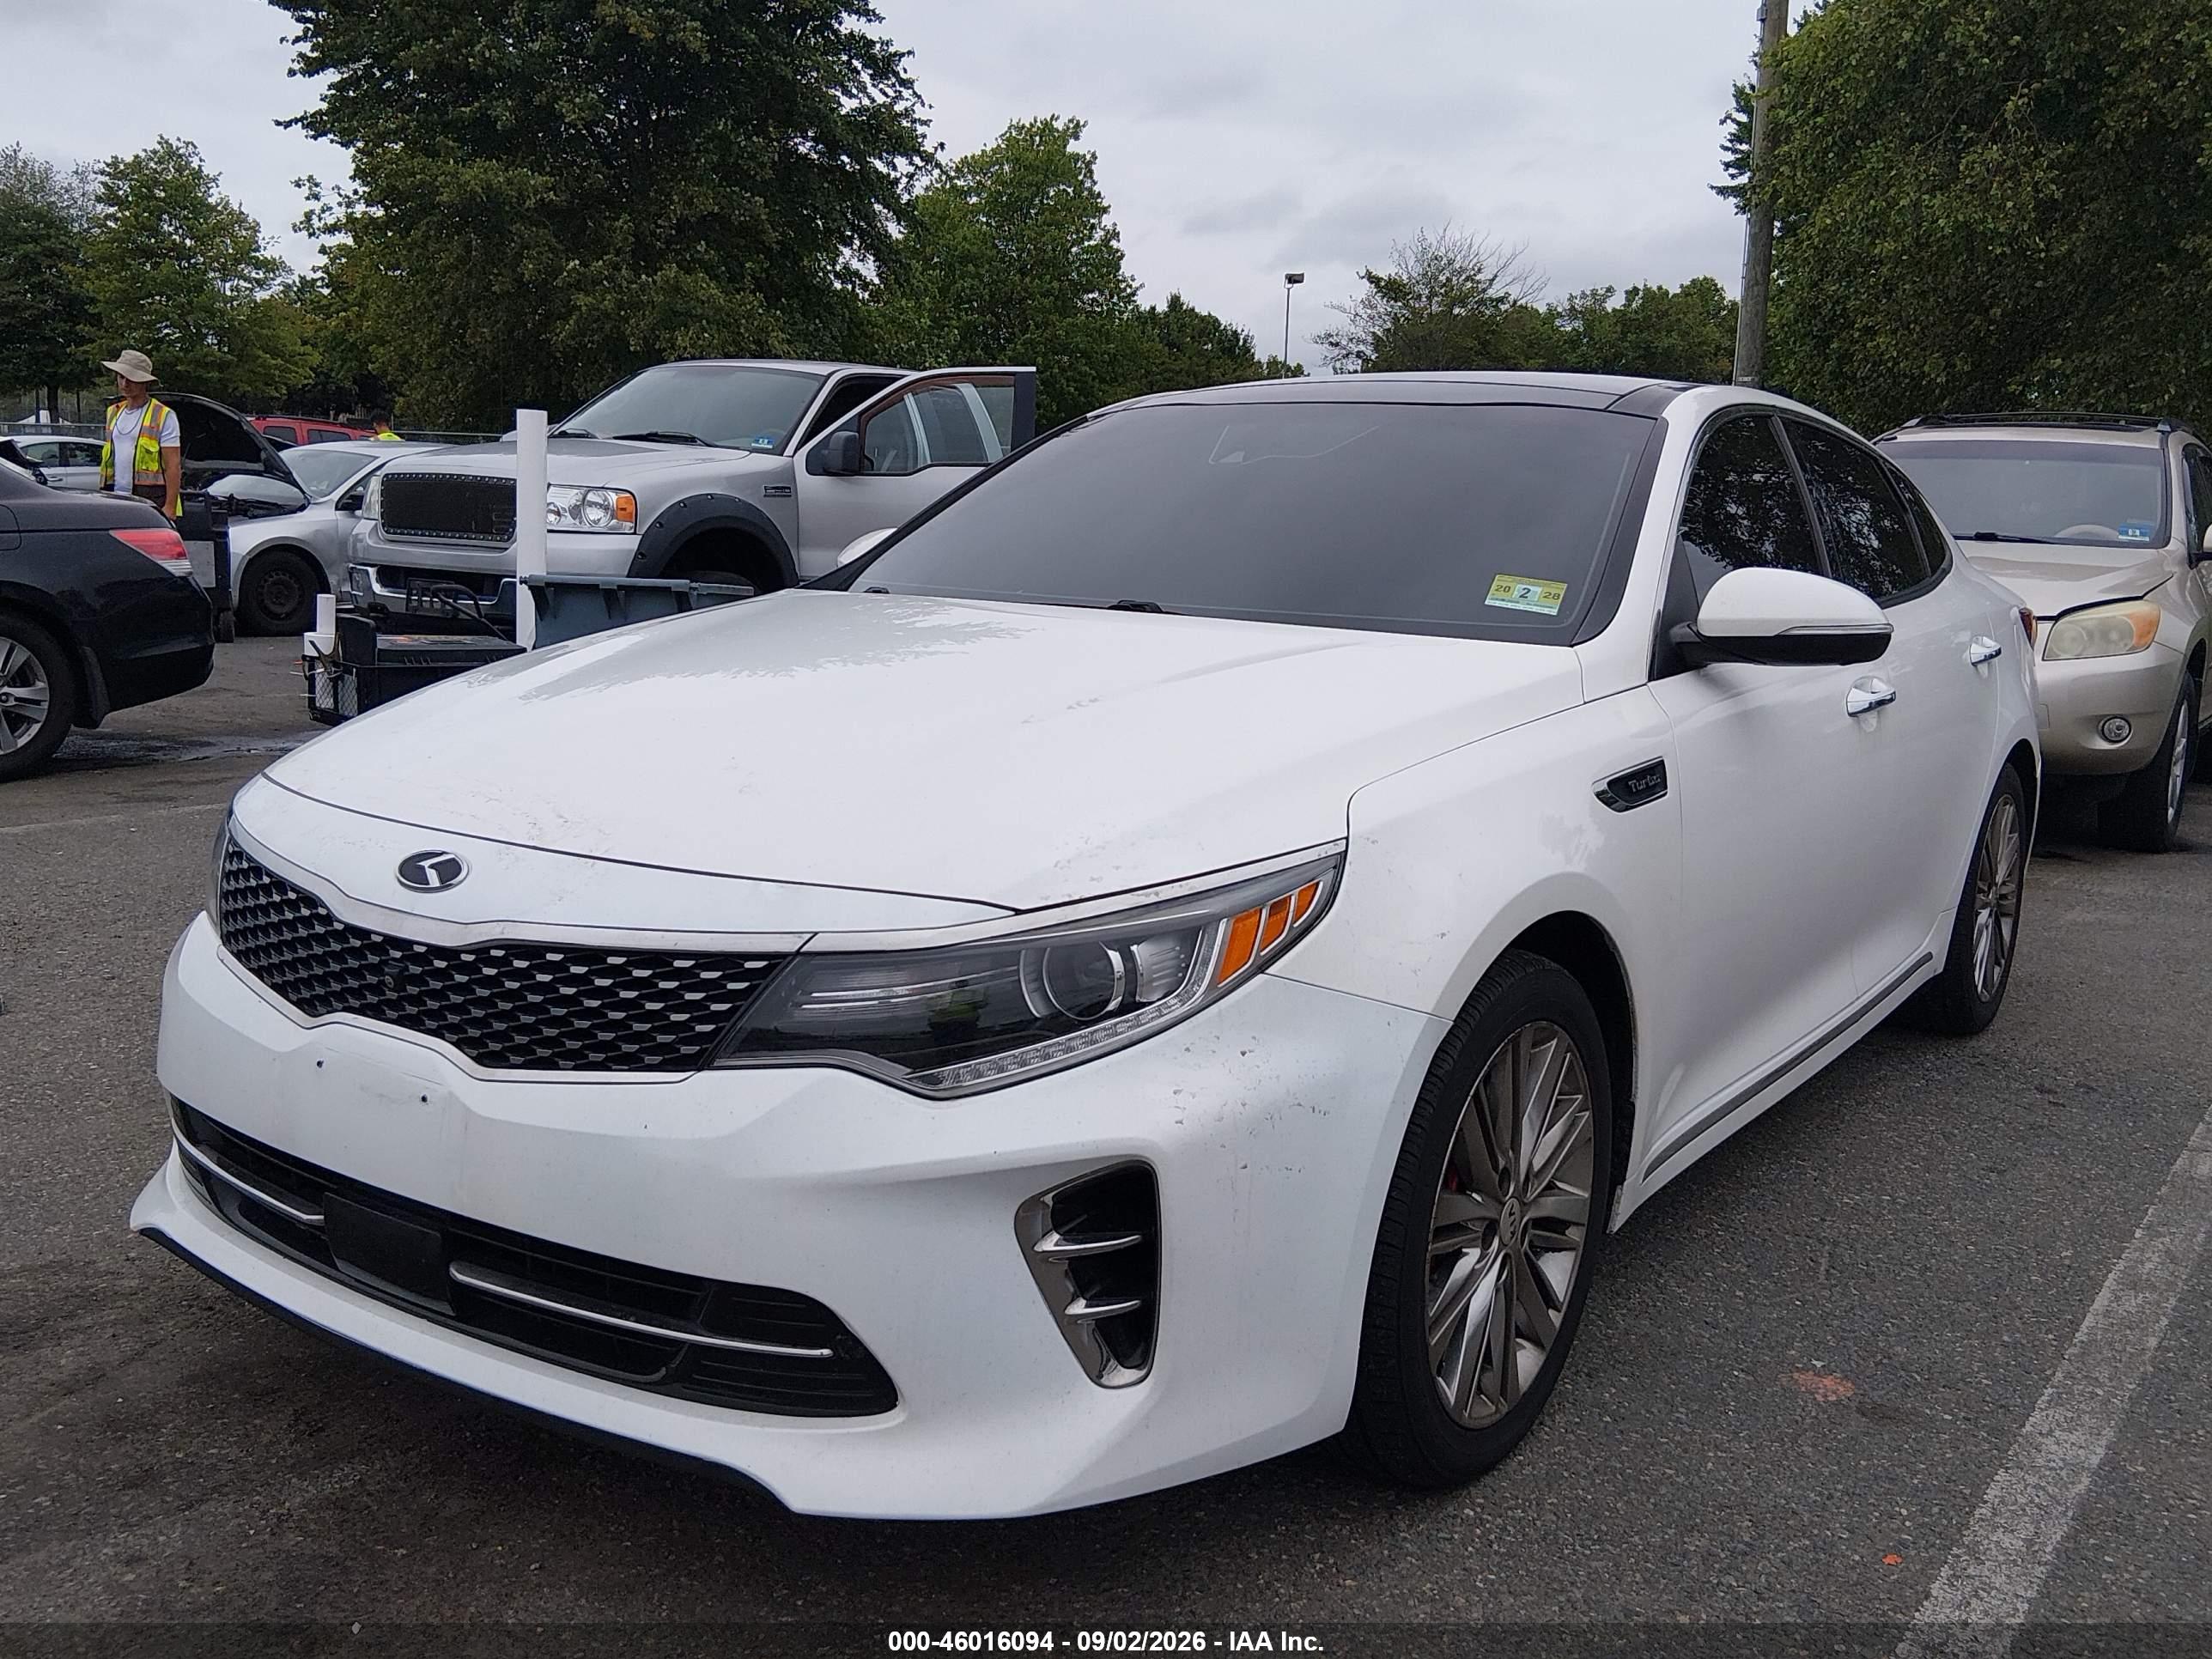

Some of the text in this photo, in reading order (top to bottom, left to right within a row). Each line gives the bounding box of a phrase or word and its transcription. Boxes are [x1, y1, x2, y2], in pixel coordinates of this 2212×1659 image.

[1494, 584, 1561, 600] 20 2 28
[1628, 775, 1662, 793] Turbo
